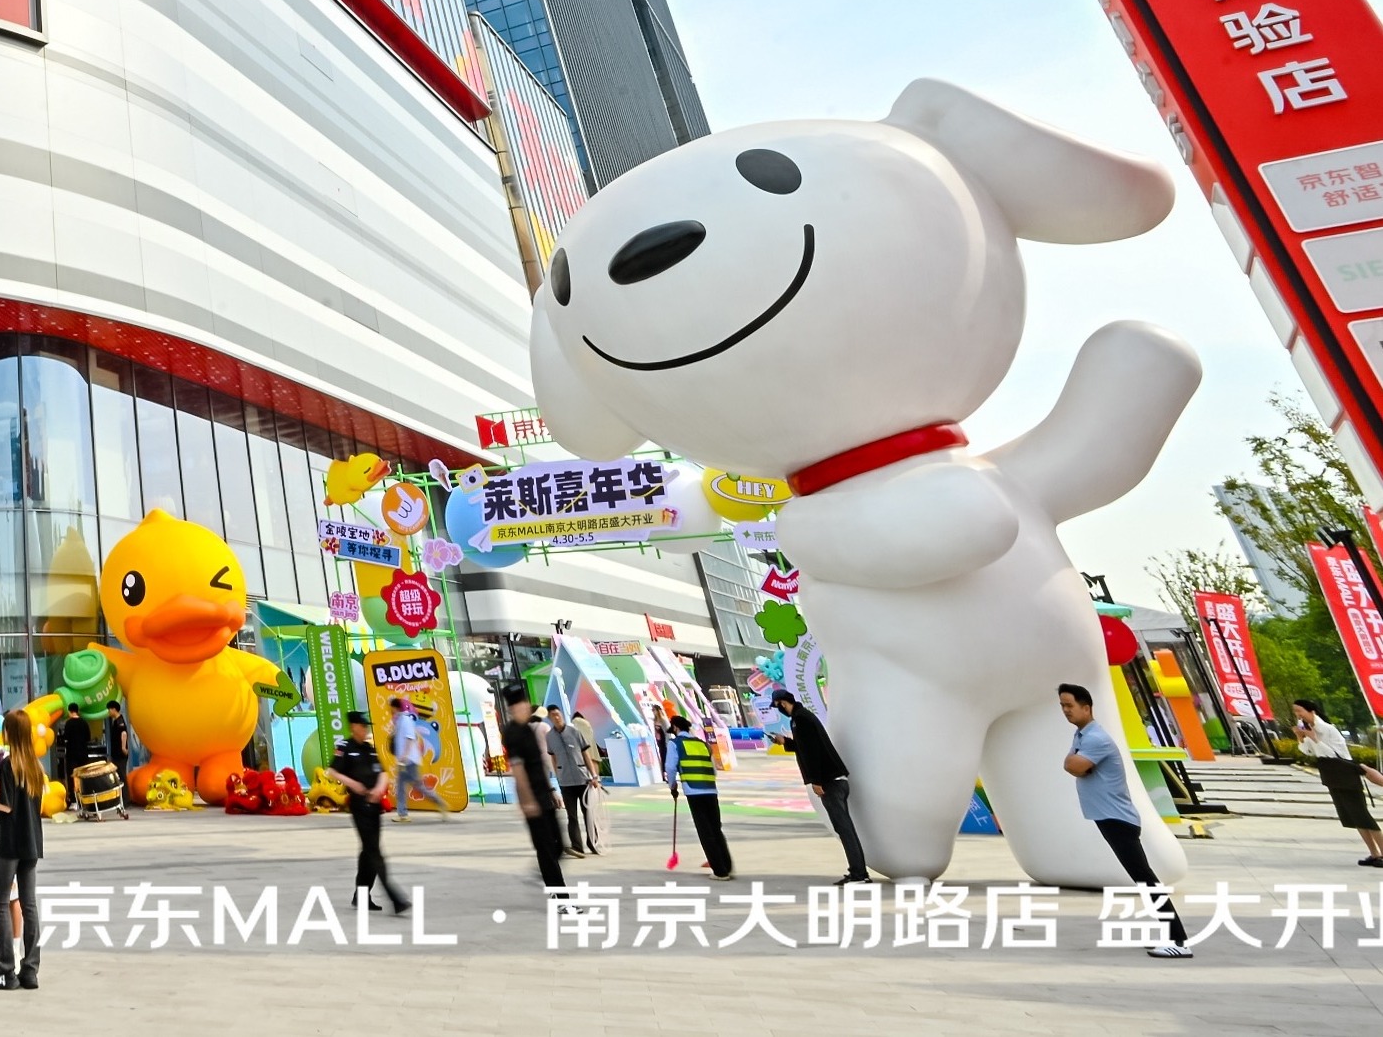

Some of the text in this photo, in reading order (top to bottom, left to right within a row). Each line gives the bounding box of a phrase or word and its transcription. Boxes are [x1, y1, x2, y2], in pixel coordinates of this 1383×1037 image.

[1321, 182, 1383, 210] 舒适
[483, 461, 666, 522] 莱斯嘉年华
[736, 480, 776, 499] HEY
[324, 522, 371, 541] 金陵宝地
[496, 513, 654, 540] 京东MALL南京大明路店盛大开业
[552, 531, 595, 545] 4.30-5.5
[346, 541, 393, 562] 等你探寻
[331, 593, 358, 612] 南京
[399, 588, 423, 602] 超级
[401, 602, 425, 617] 好玩
[319, 630, 339, 705] WELCOME
[329, 707, 343, 732] TO
[375, 661, 435, 684] B.DUCK
[259, 686, 294, 701] WELCOME
